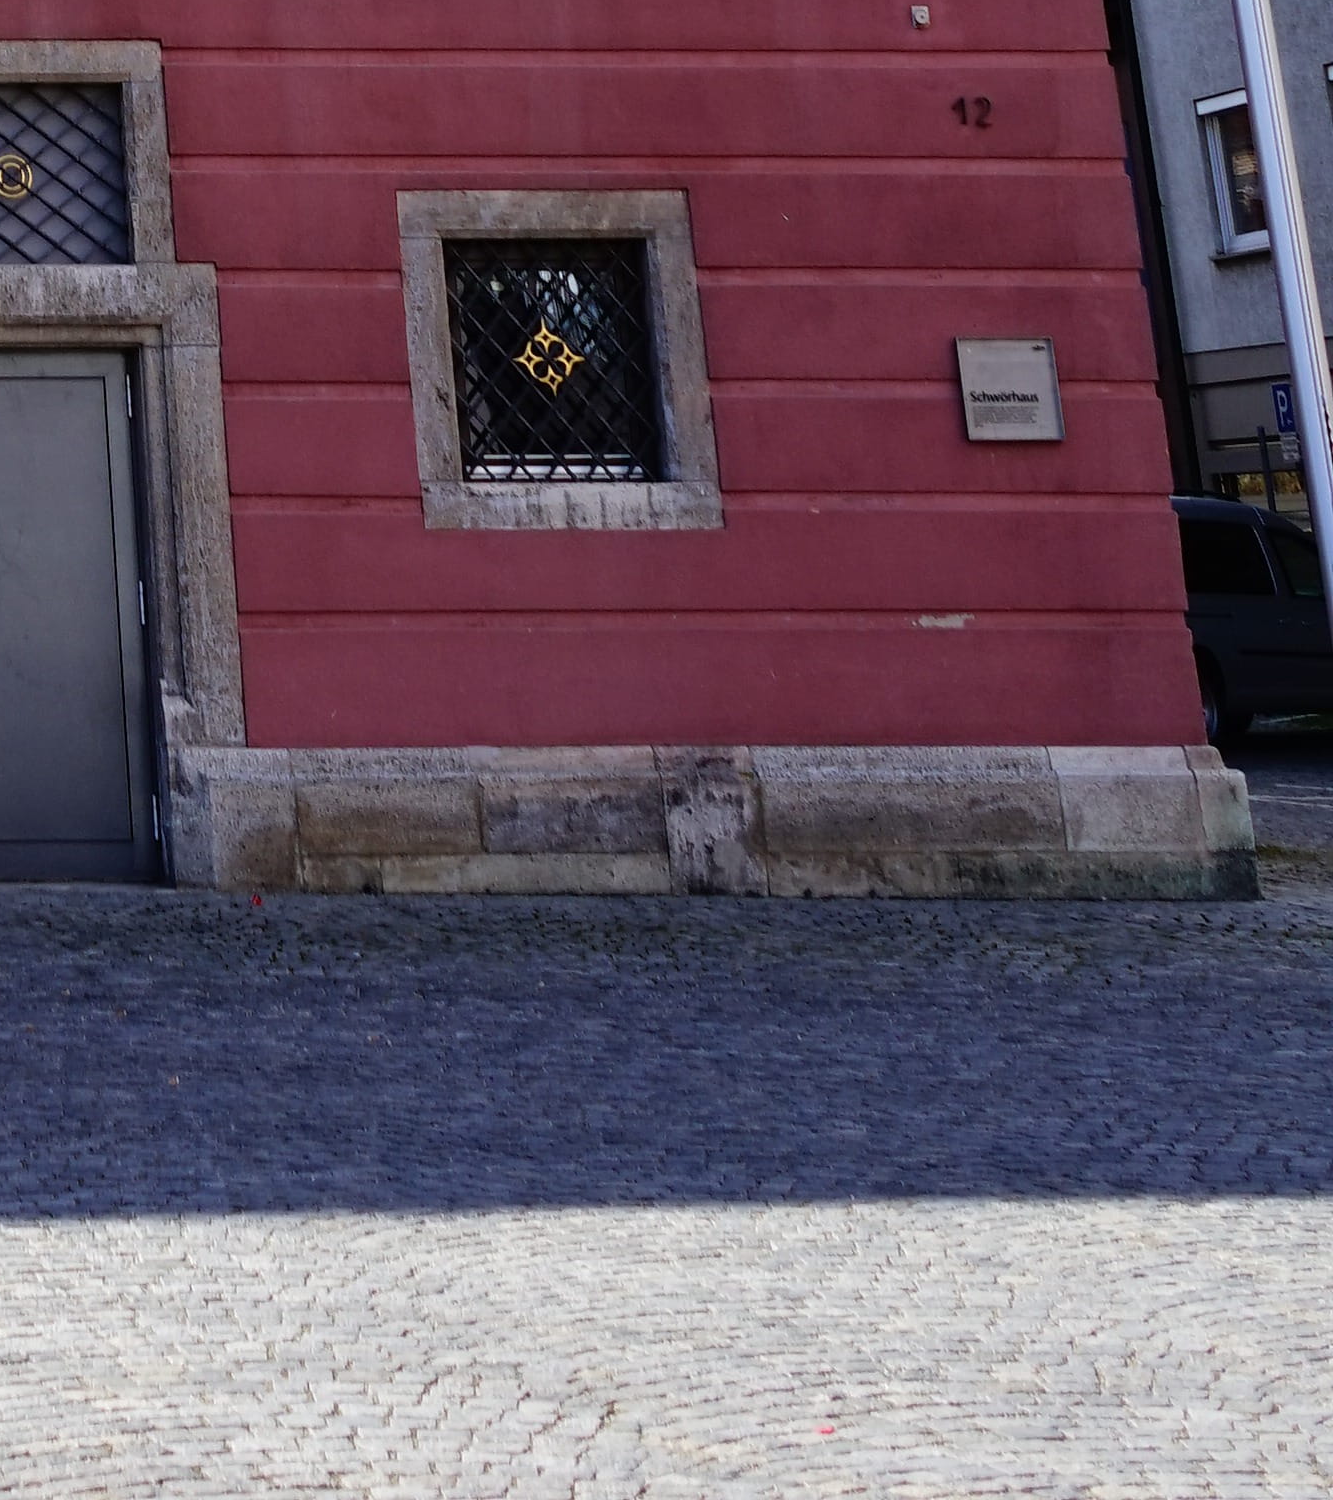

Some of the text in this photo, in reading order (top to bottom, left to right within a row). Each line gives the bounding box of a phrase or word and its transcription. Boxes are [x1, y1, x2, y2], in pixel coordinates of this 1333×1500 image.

[951, 96, 993, 130] 12
[969, 389, 1039, 404] Schwörhaus
[1276, 389, 1289, 428] P
